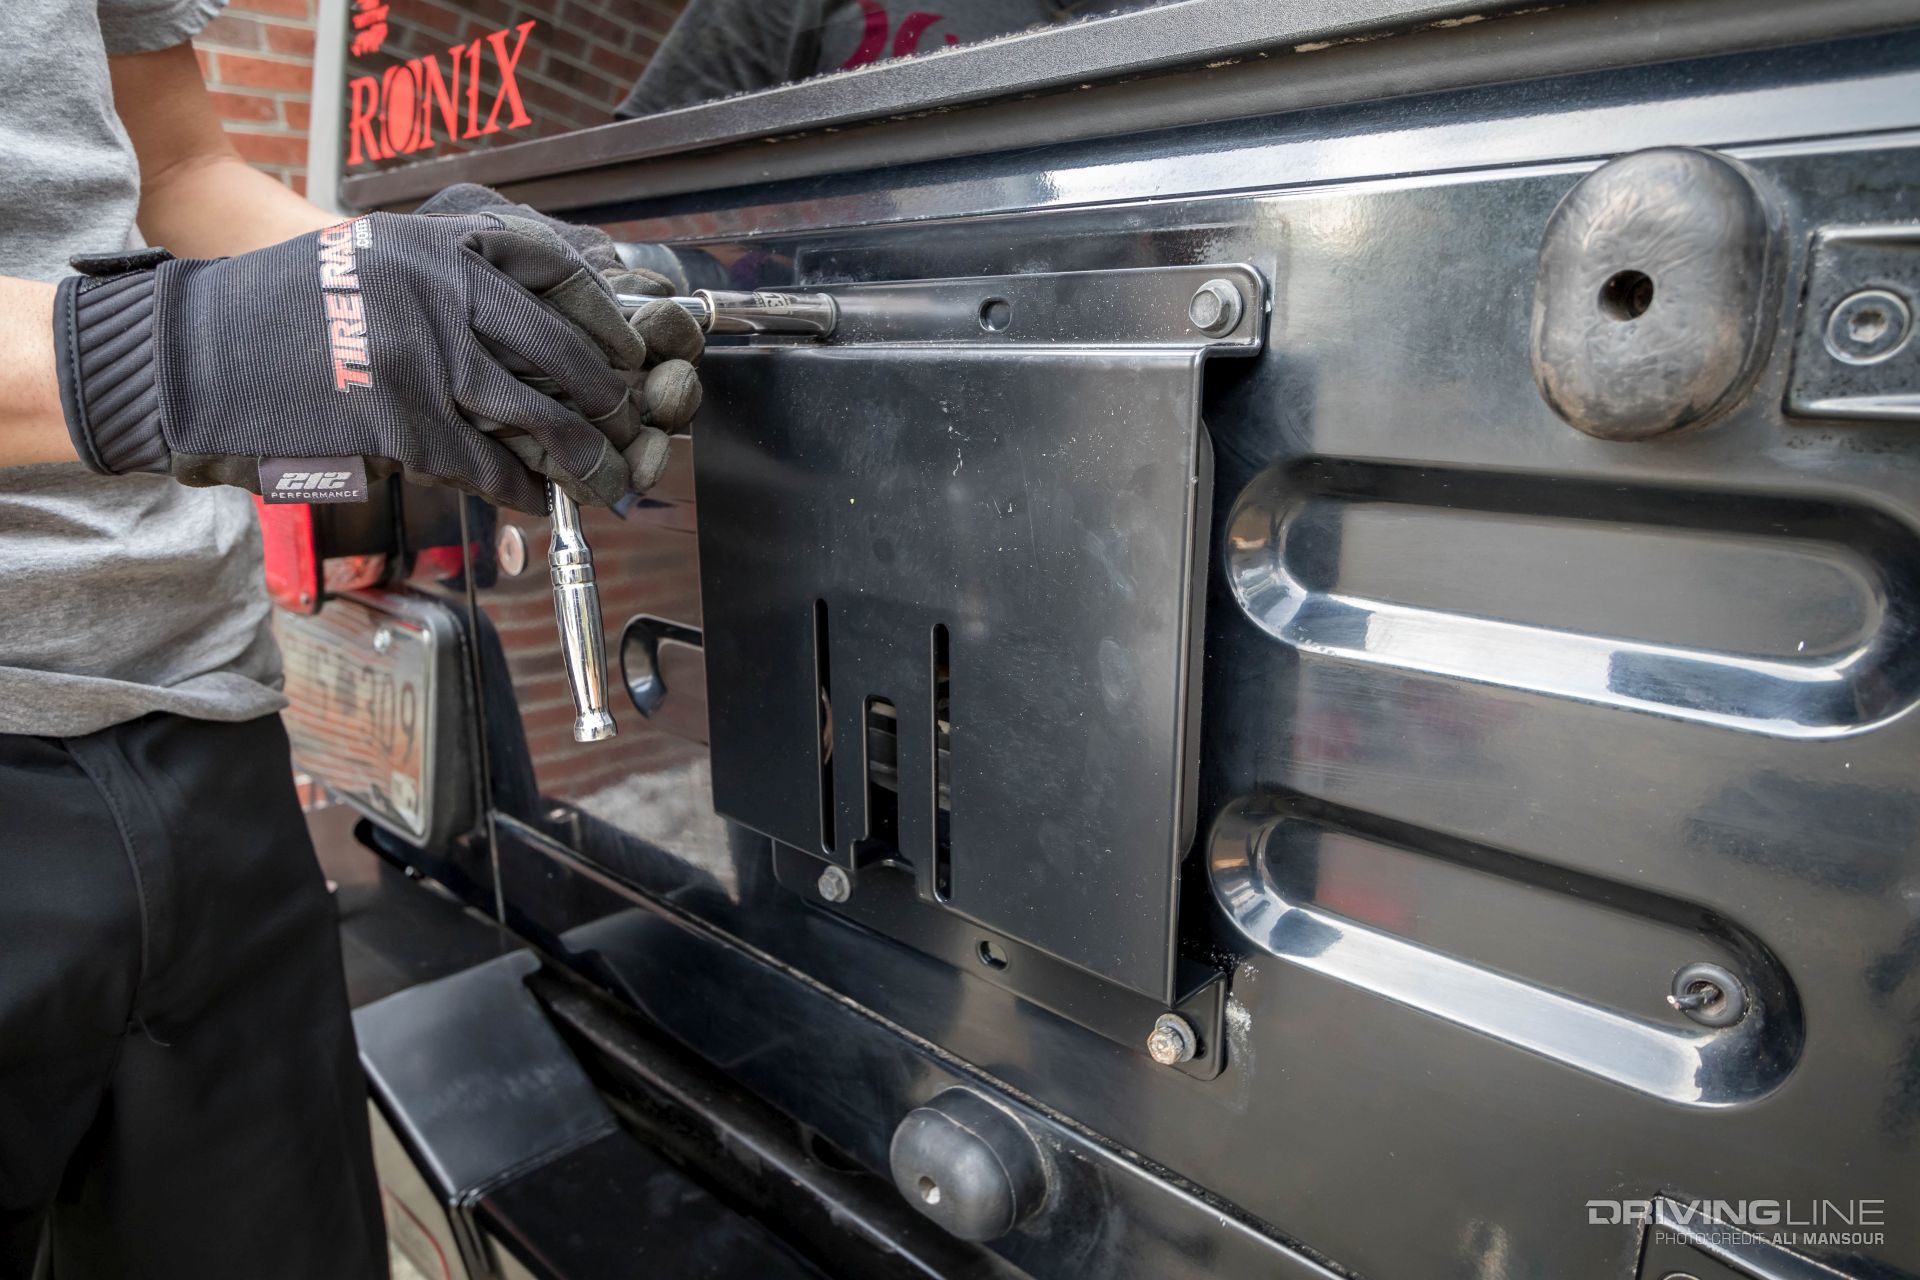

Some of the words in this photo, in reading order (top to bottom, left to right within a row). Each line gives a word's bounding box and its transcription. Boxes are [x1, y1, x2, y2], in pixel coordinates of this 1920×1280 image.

[319, 217, 361, 289] RAC
[327, 292, 372, 393] TIRE
[271, 490, 360, 499] PERFORMANCE
[275, 471, 352, 490] 212
